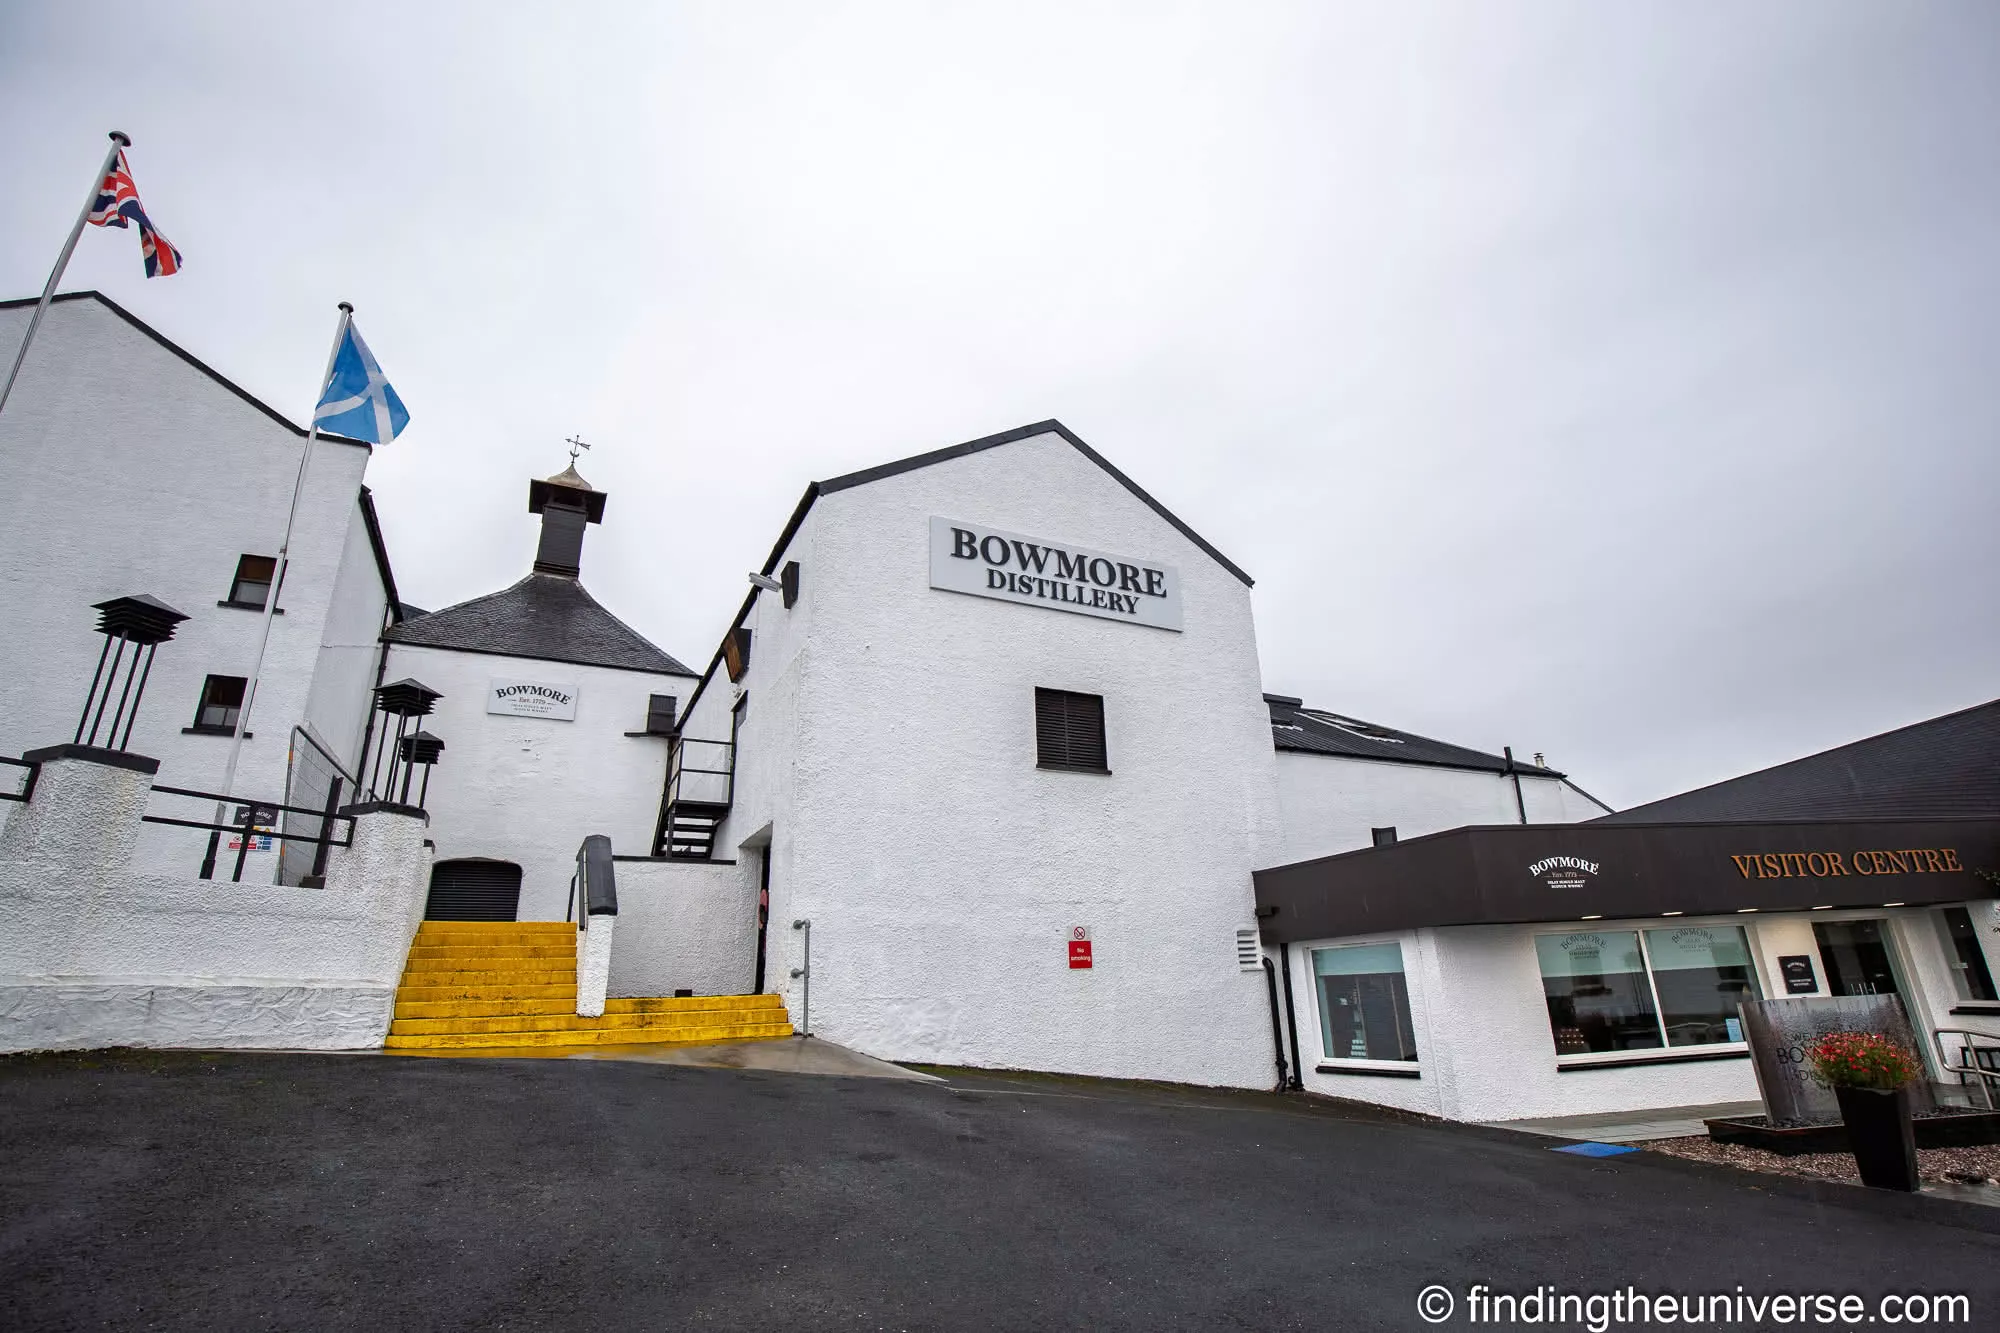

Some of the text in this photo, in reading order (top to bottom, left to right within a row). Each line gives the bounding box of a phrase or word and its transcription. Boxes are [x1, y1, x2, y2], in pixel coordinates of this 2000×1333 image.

[950, 527, 1167, 598] BOWMORE
[986, 568, 1139, 613] DISTILLERY
[496, 686, 571, 705] BOWMORE
[240, 811, 272, 819] BOMORE
[1528, 856, 1599, 876] BOWMORE
[1731, 849, 1963, 879] VISITOR CENTRE
[1560, 934, 1606, 950] BOWMORE
